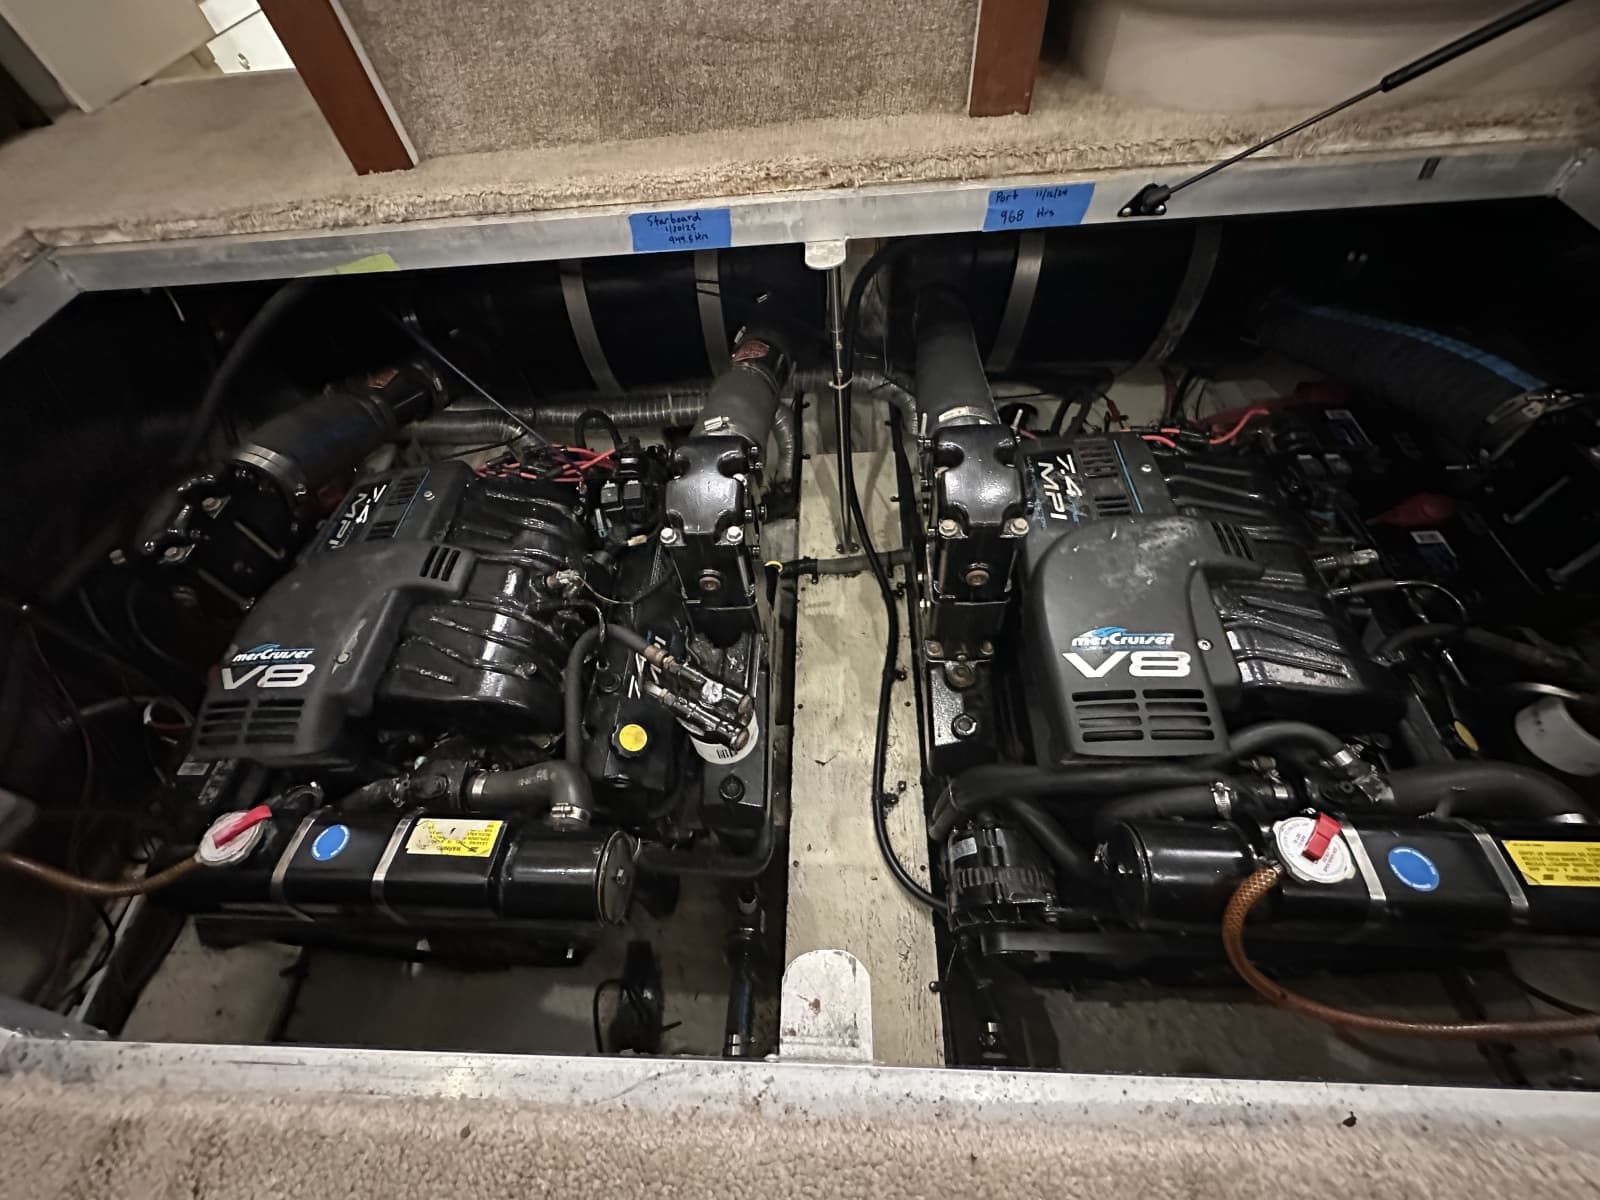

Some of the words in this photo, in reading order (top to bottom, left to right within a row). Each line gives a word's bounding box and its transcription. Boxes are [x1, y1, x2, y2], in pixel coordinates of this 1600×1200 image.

[996, 190, 1019, 203] Port
[646, 211, 702, 227] Starboard
[1000, 209, 1025, 224] 968
[1036, 206, 1055, 218] Hrs
[1056, 453, 1083, 497] 7.4
[355, 484, 387, 524] 7.4
[1037, 461, 1068, 520] MPI
[328, 493, 368, 546] MPI
[221, 663, 316, 690] V8
[1061, 650, 1192, 678] V8
